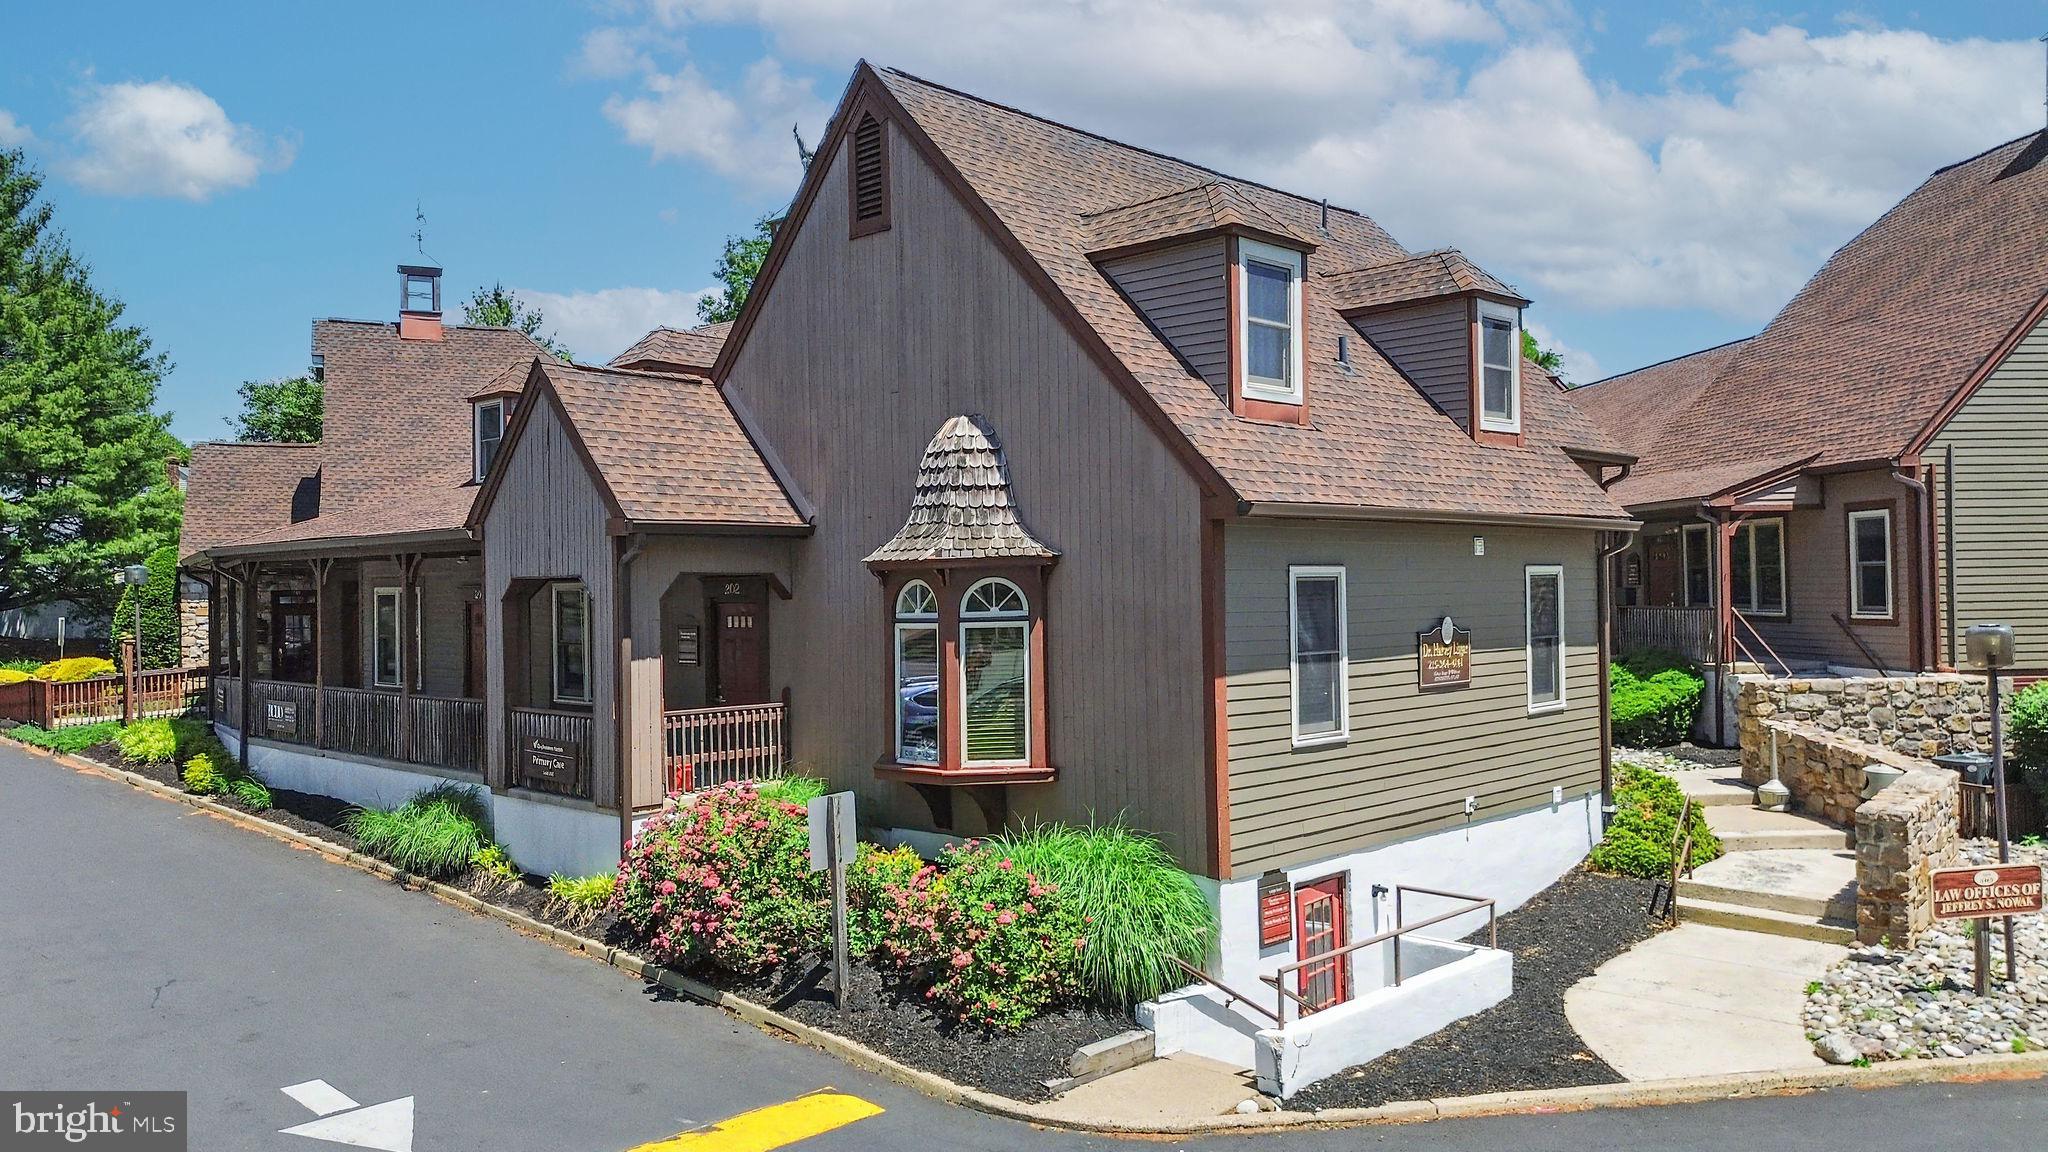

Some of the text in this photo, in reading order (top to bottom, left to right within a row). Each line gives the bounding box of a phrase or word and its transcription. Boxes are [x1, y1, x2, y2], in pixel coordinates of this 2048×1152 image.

[725, 583, 740, 595] 202
[532, 755, 553, 770] Primary
[1934, 882, 2041, 903] LAW OFFICES OF
[1940, 896, 2035, 915] JEFFREY S. NOWAK
